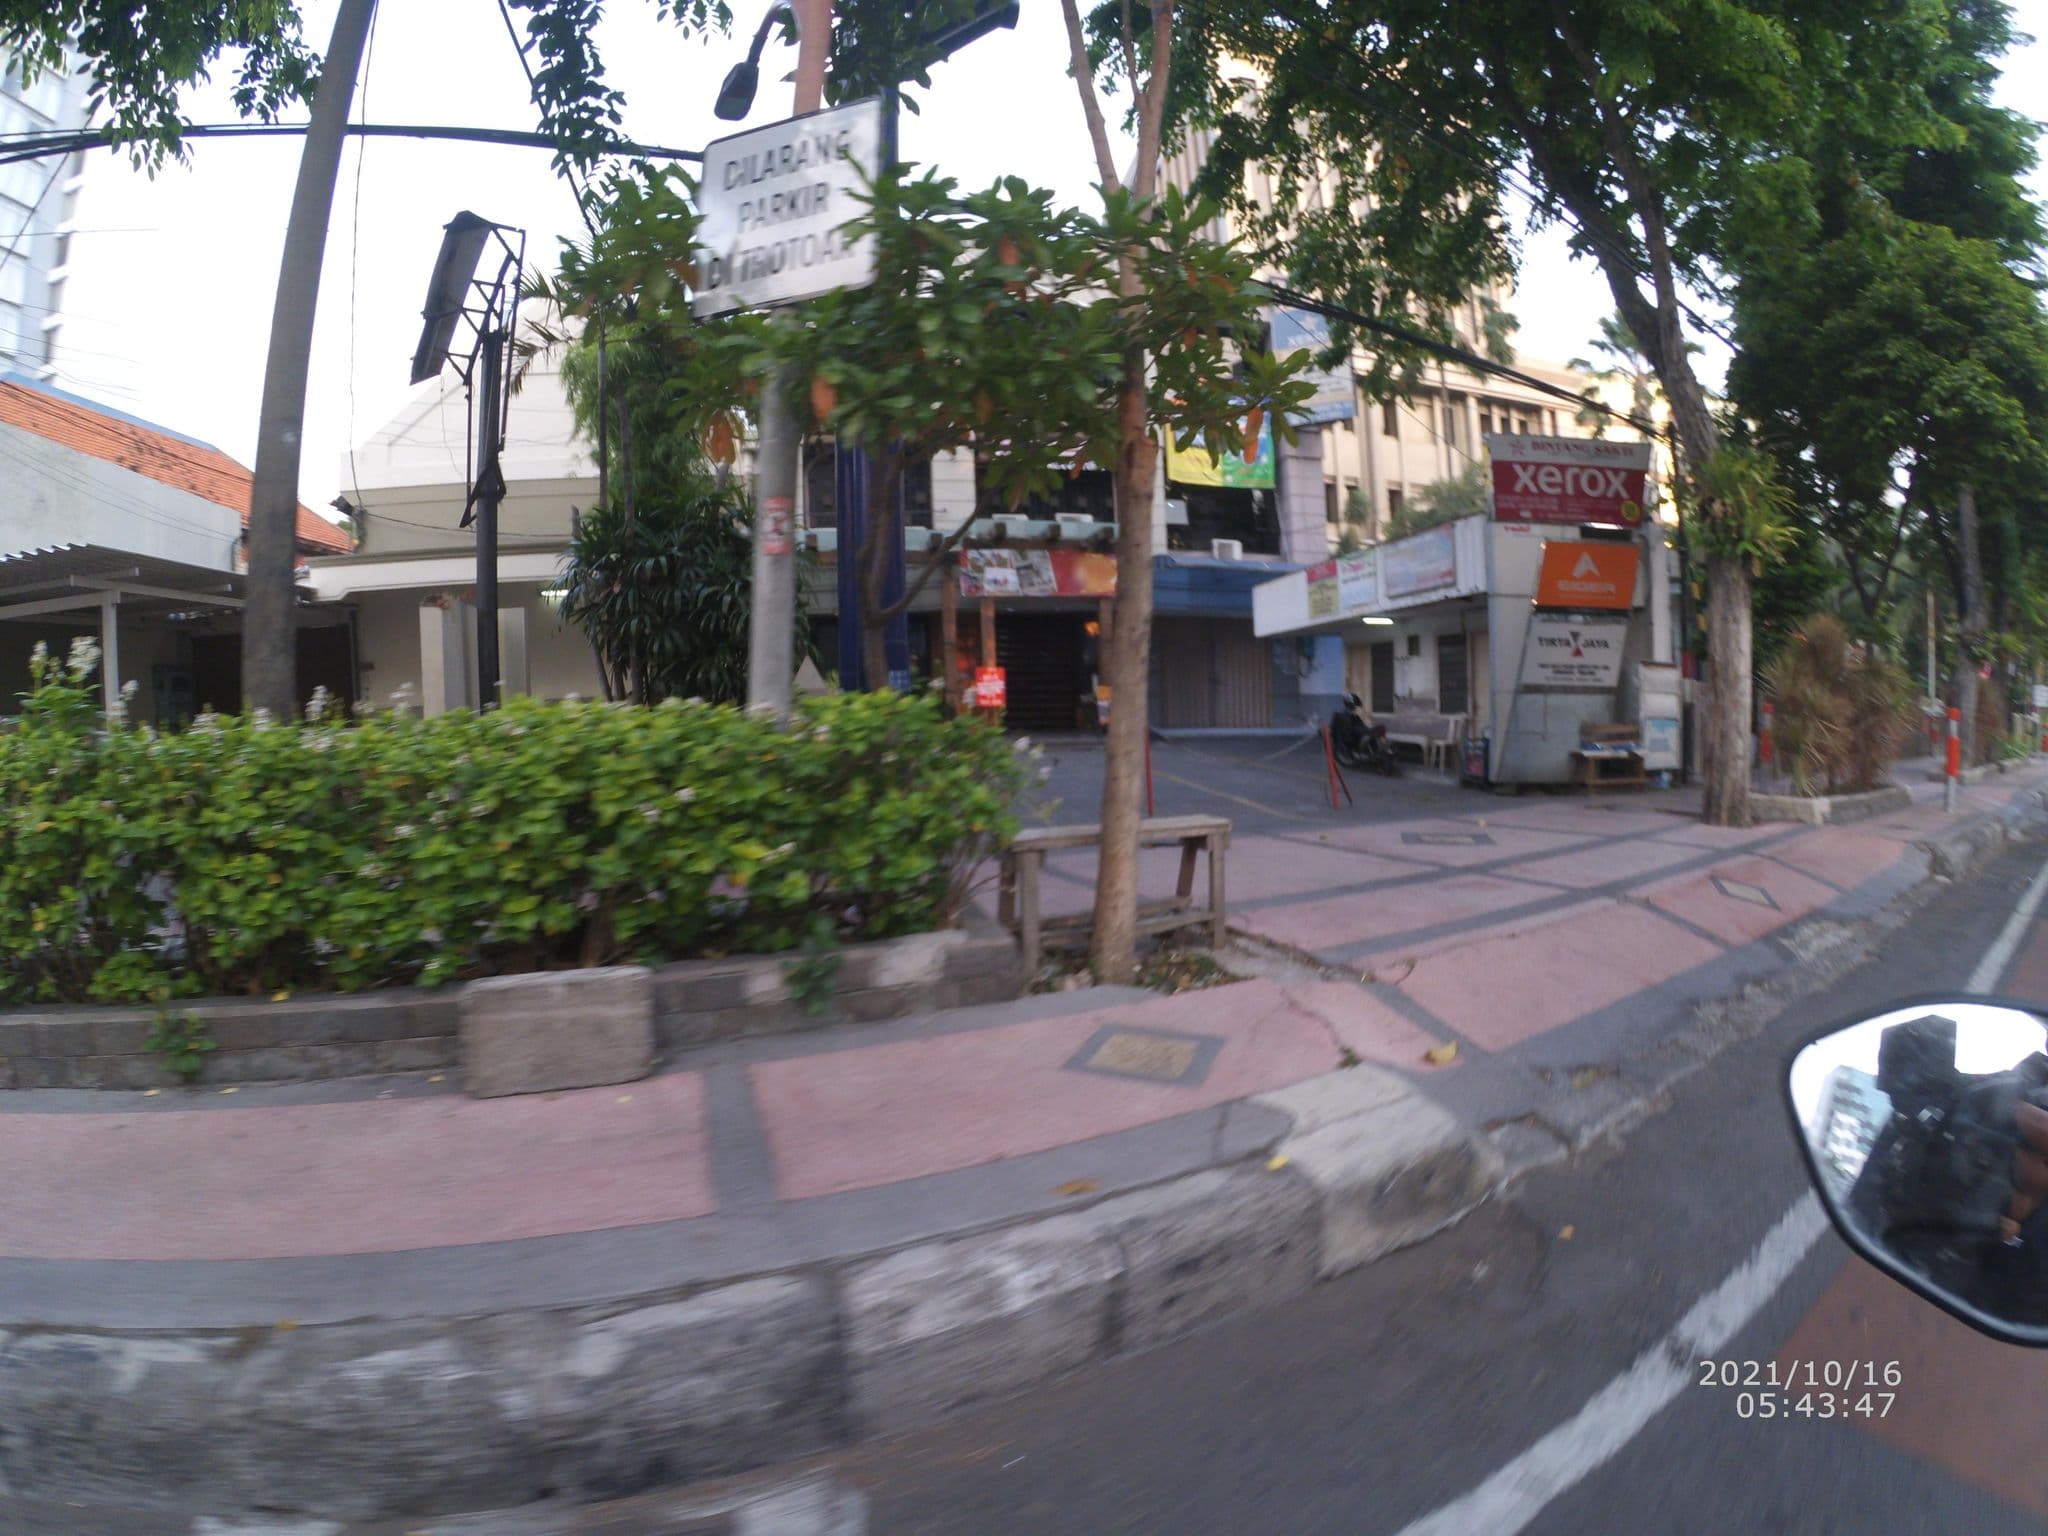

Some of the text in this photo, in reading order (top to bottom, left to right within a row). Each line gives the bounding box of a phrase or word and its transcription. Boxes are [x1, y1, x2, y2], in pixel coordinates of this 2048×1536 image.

[738, 182, 829, 233] PARKIR
[1512, 463, 1630, 499] xerox
[1537, 637, 1610, 649] TIRTA JAYA
